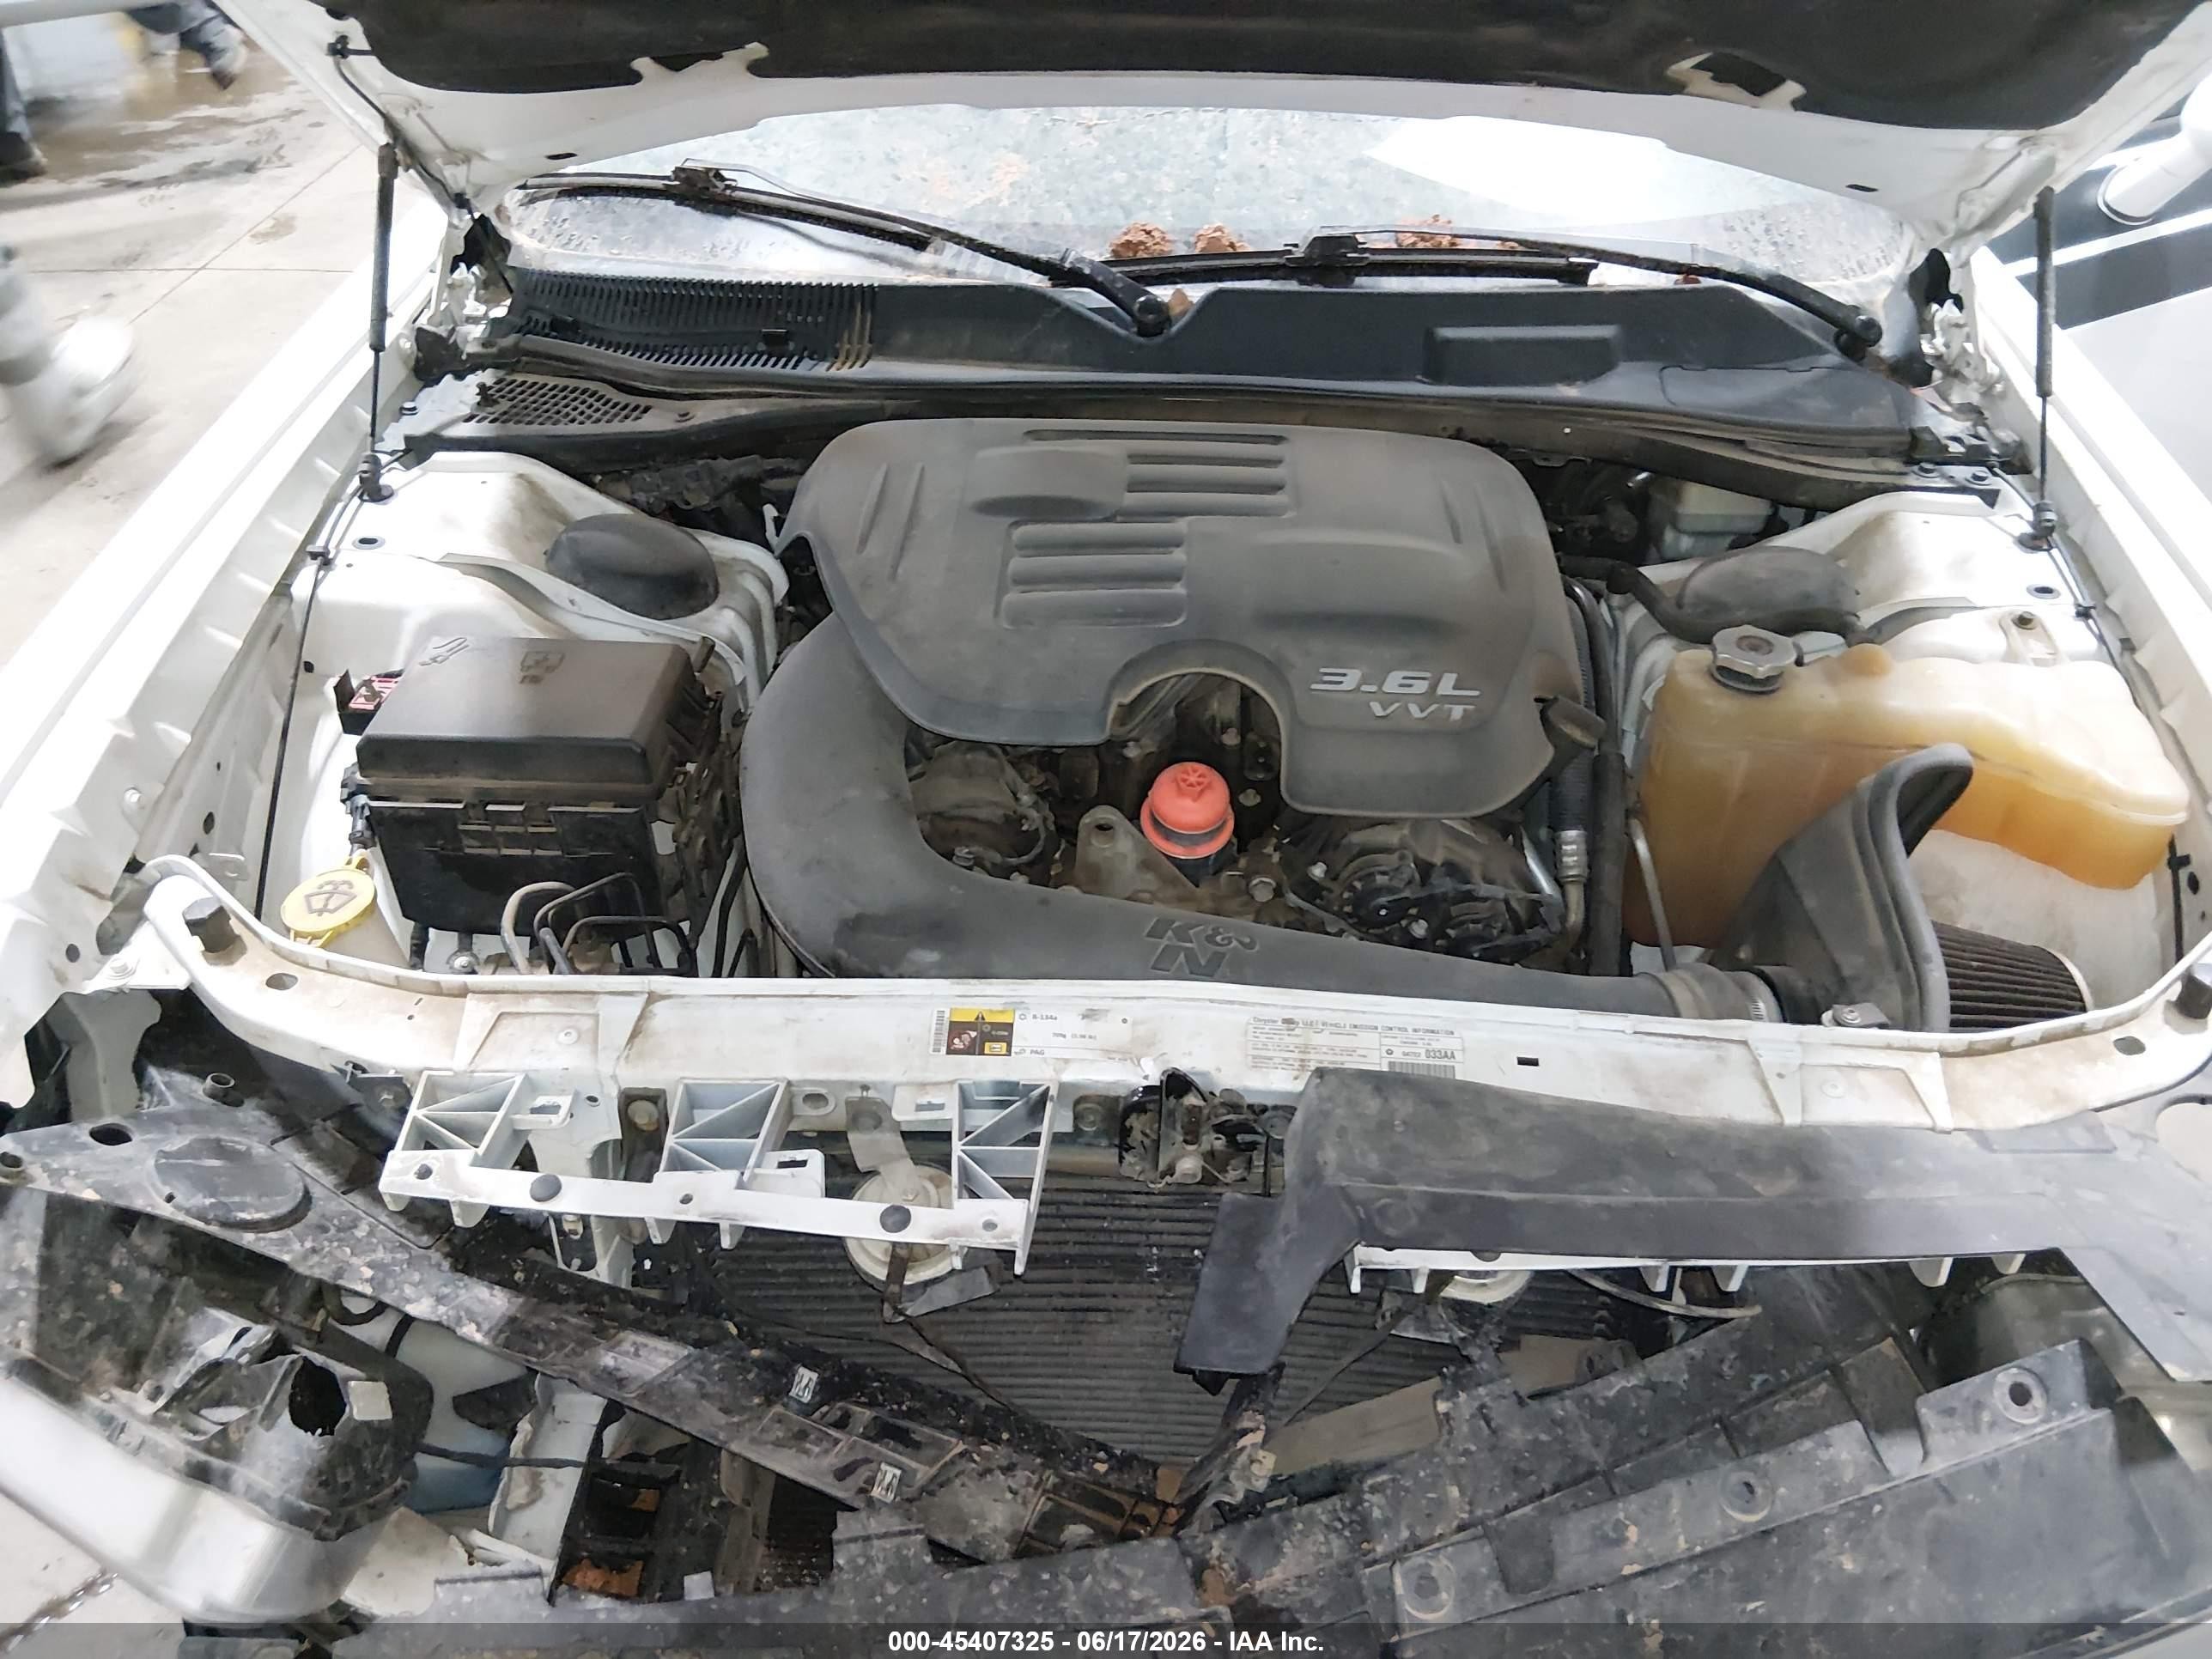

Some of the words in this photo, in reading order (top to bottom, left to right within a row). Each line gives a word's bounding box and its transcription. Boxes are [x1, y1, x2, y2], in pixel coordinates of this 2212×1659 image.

[1310, 667, 1481, 697] 3.6L
[1369, 701, 1476, 722] VVT
[1144, 917, 1259, 977] K&N
[1381, 1024, 1409, 1033] CONTROL
